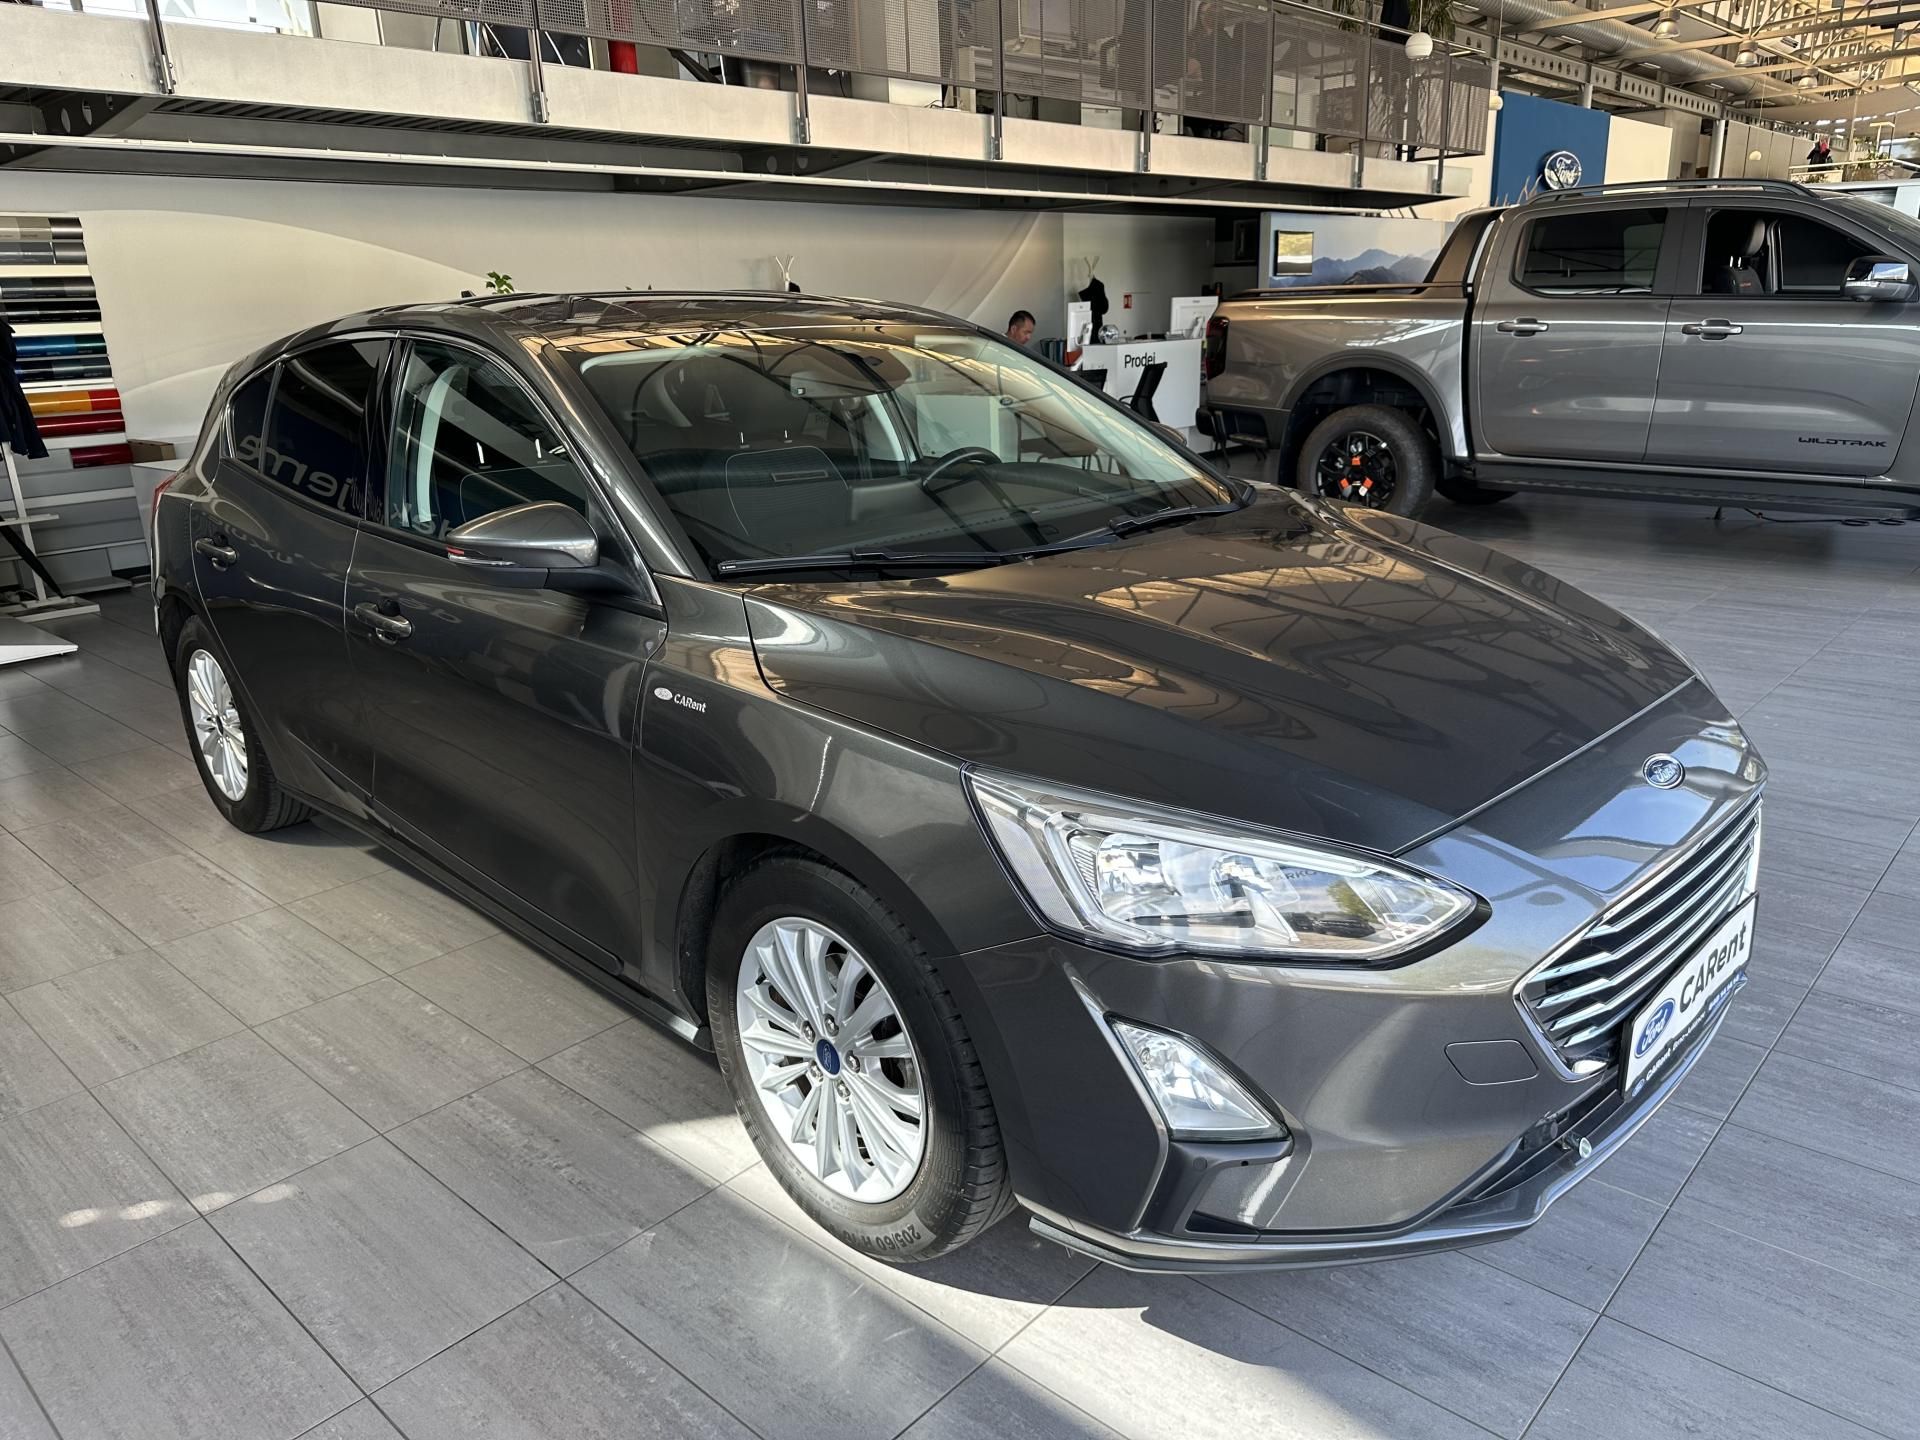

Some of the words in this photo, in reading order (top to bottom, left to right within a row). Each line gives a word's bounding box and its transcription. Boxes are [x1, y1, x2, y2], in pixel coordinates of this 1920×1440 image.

[1548, 155, 1580, 187] Ford
[1798, 436, 1887, 447] WILDTRAK
[674, 693, 706, 713] CARent
[1639, 1003, 1671, 1054] Ford
[1679, 921, 1747, 1014] CARent
